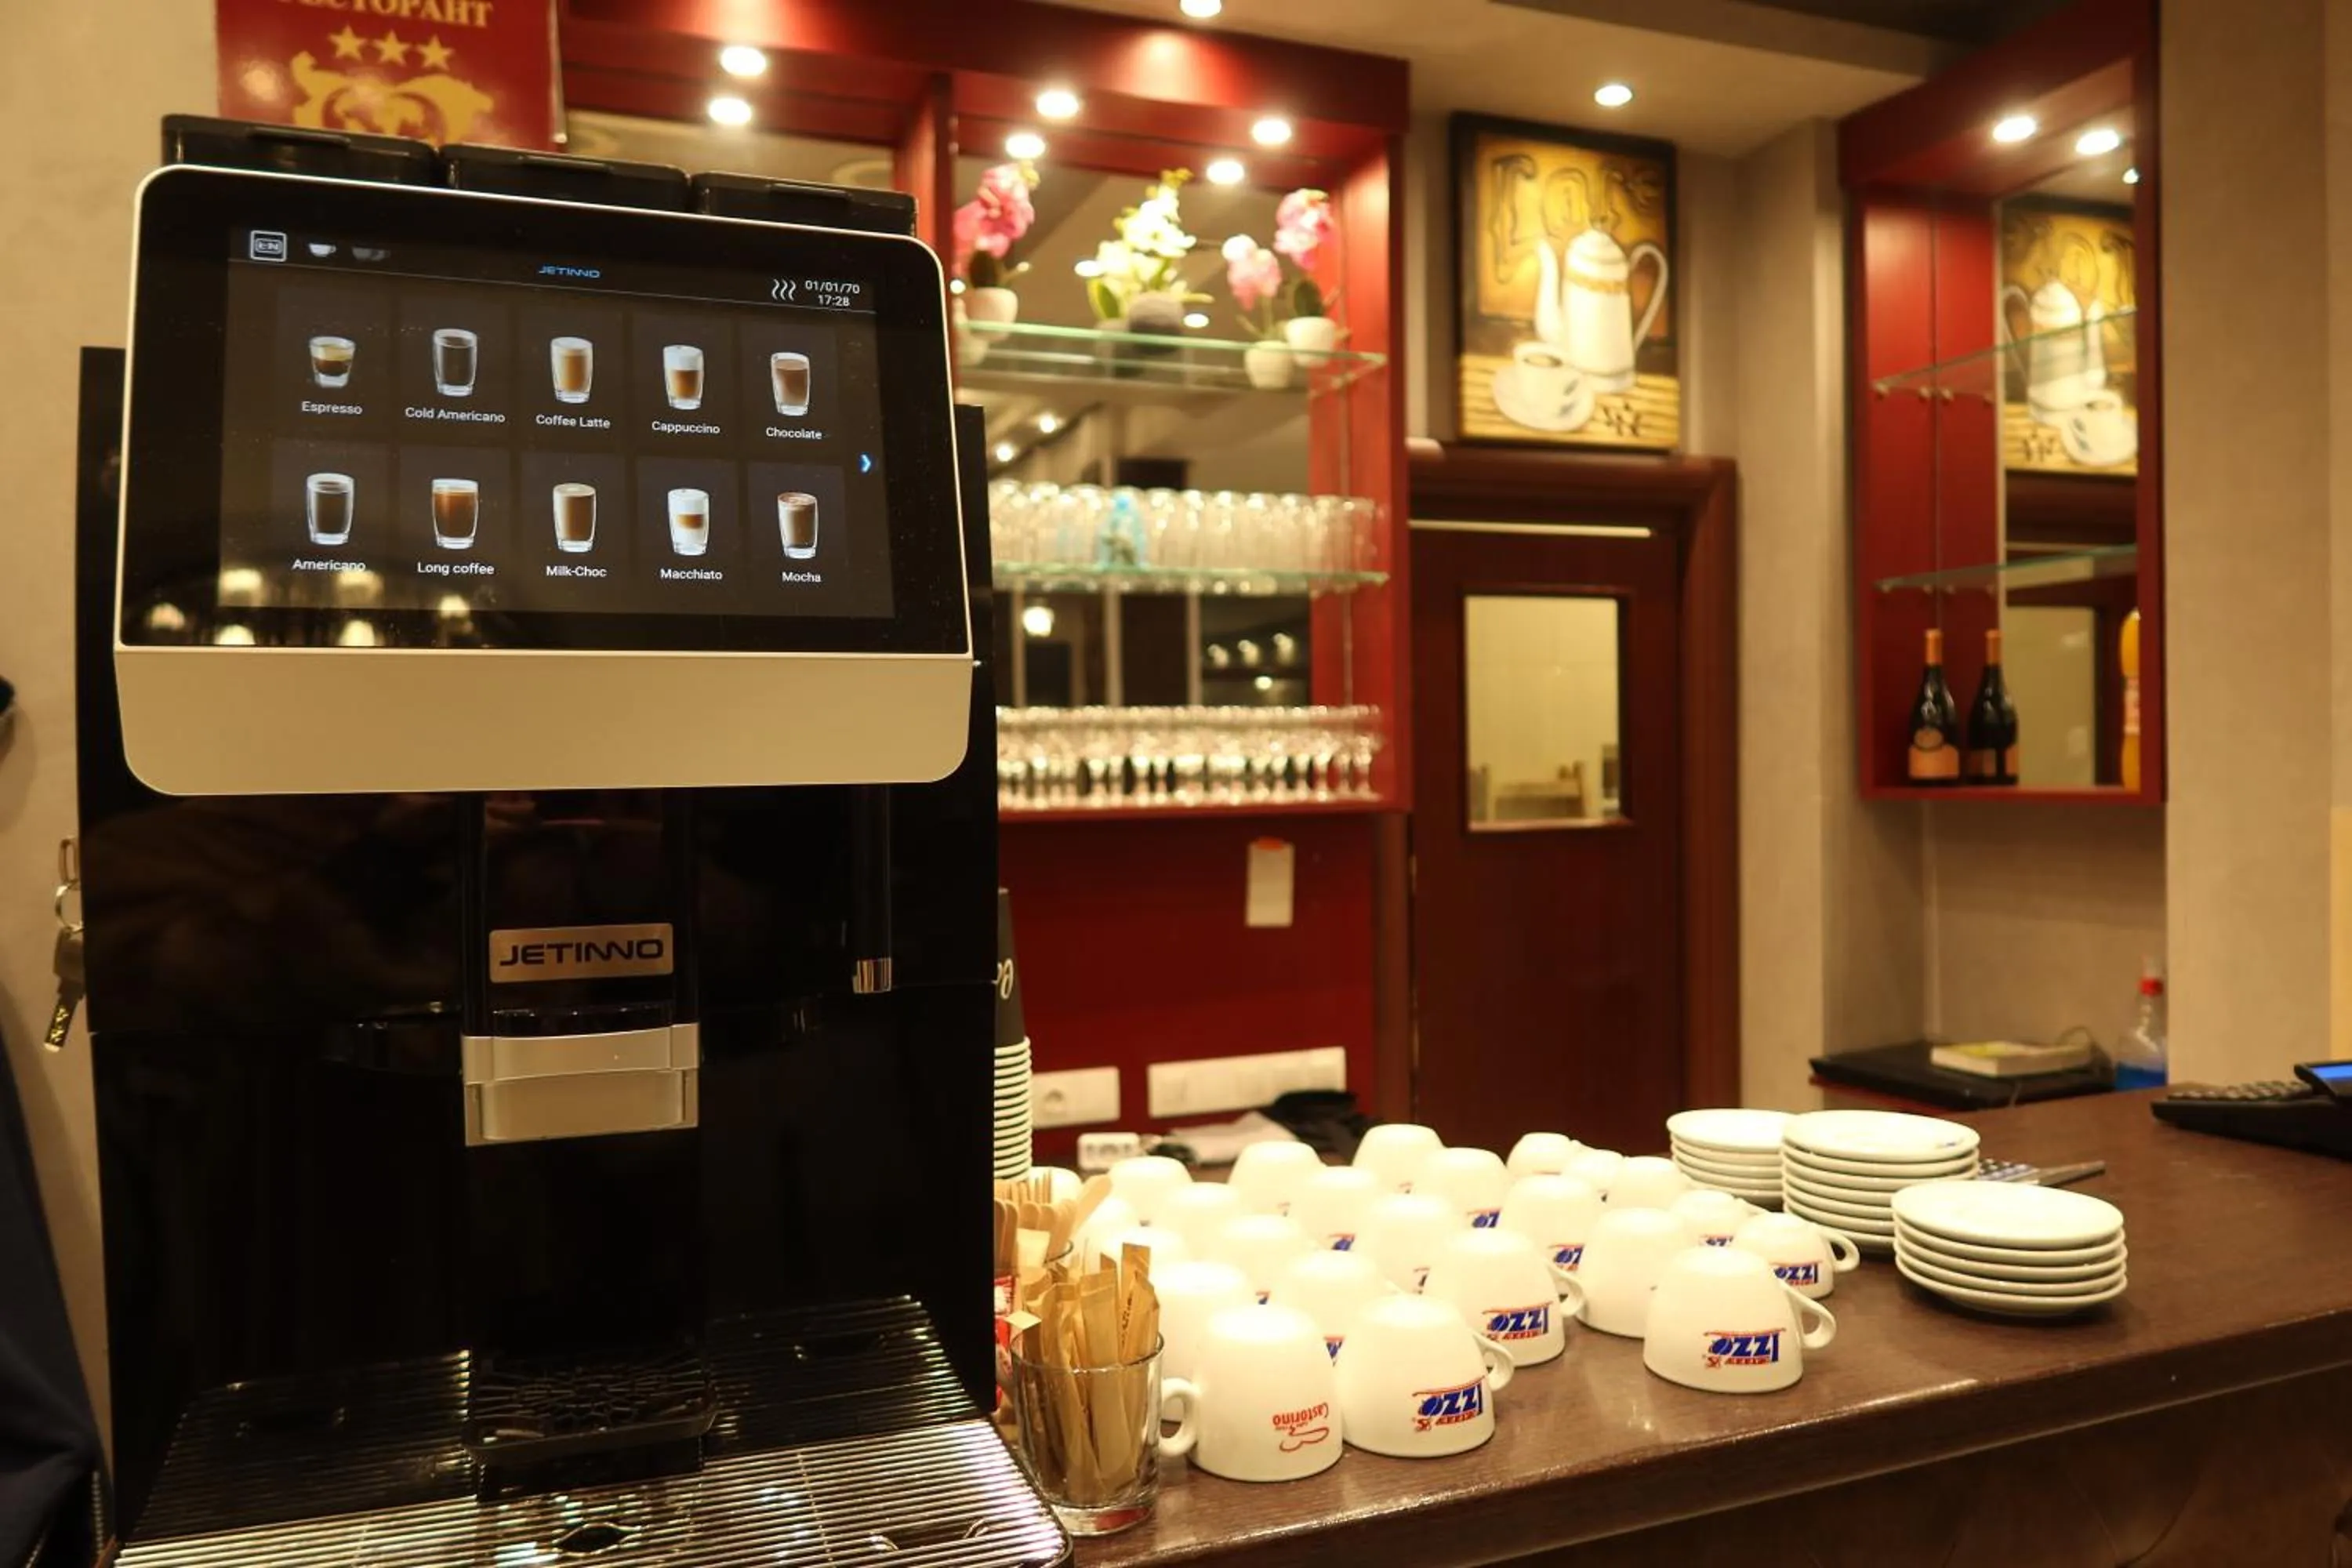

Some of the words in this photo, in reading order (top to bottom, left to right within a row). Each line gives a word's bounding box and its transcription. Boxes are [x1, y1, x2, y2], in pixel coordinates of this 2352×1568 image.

[538, 265, 601, 278] JETINNO
[804, 279, 860, 295] 01/01/70
[818, 294, 851, 307] 17:28
[301, 401, 363, 416] Espresso
[405, 407, 434, 419] Cold
[437, 408, 506, 423] Americano
[535, 414, 576, 427] Coffee
[579, 416, 611, 429] Latte
[652, 420, 720, 435] Cappuccino
[765, 426, 822, 440] Chocolate
[292, 558, 366, 572] Americano
[417, 561, 449, 576] Long
[452, 562, 495, 575] coffee
[546, 565, 607, 578] Milk-Choc
[660, 568, 723, 581] Macchiato
[782, 572, 822, 583] Mocha
[499, 938, 664, 966] JETINNO
[1272, 1403, 1329, 1425] Castorino
